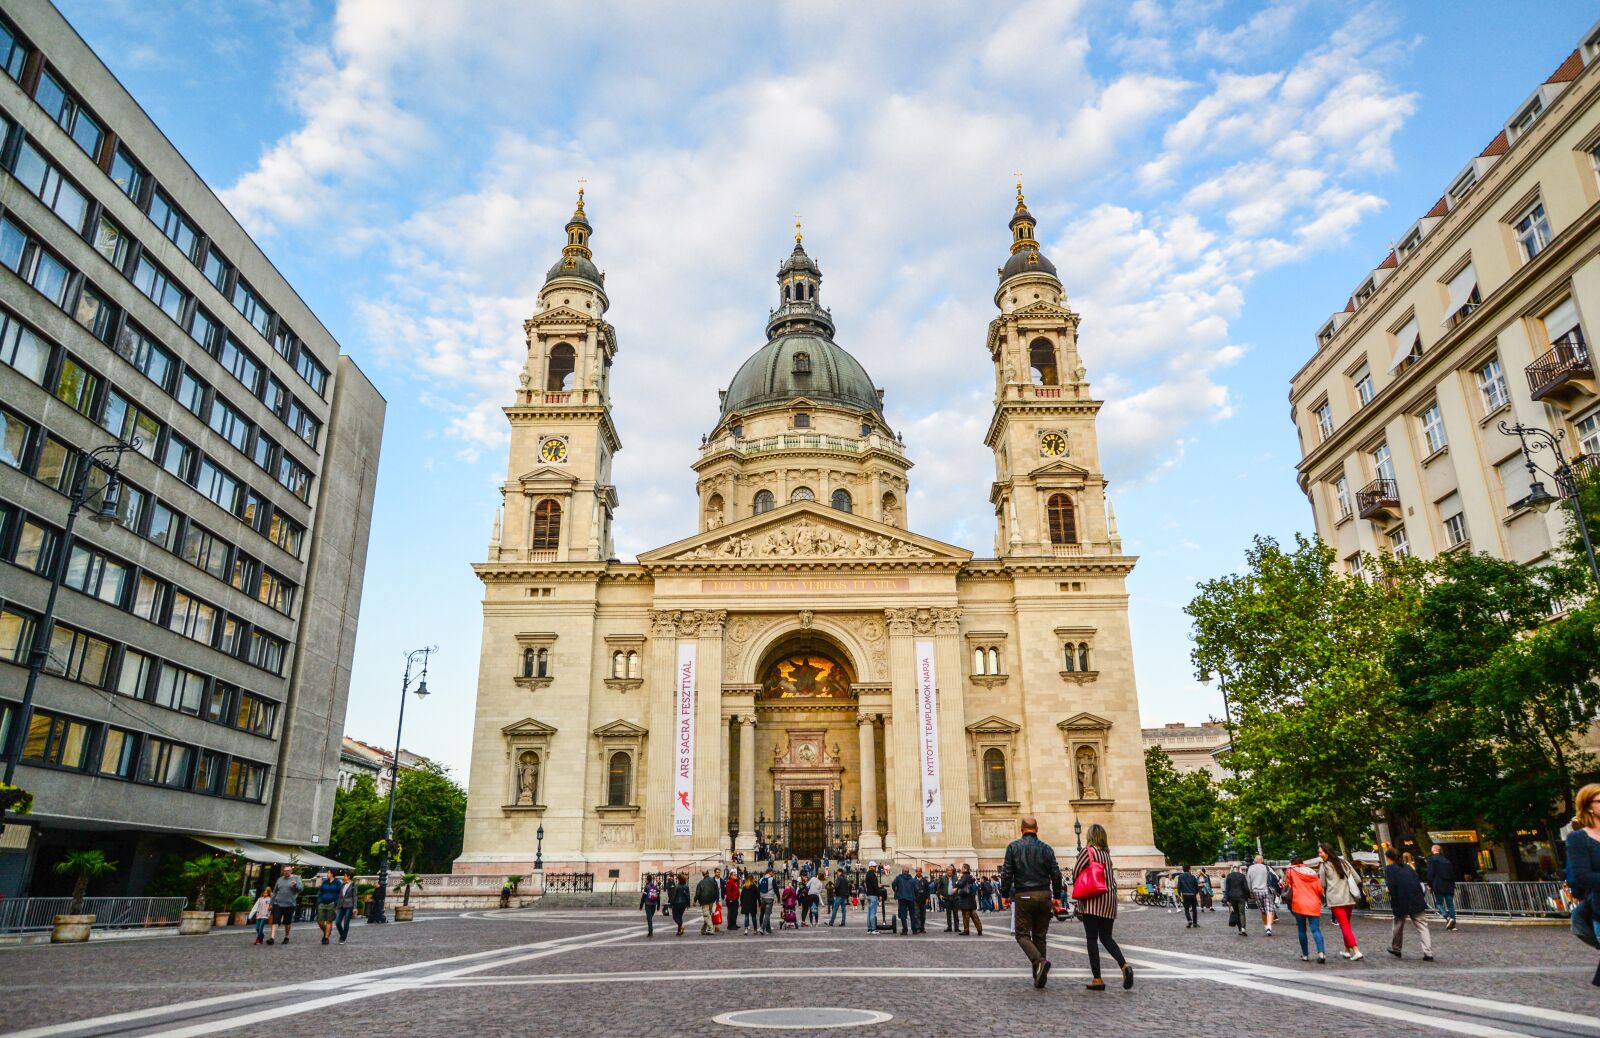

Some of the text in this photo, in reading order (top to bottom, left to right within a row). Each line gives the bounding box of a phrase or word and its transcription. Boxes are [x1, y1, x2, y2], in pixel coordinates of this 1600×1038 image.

[713, 580, 897, 591] EGO SUM VIA VERITAS ET VITA
[680, 660, 692, 778] ARS SACRA FESZTIVÁL
[922, 657, 934, 776] NYITOTT TEMPLOMOK NAPJA
